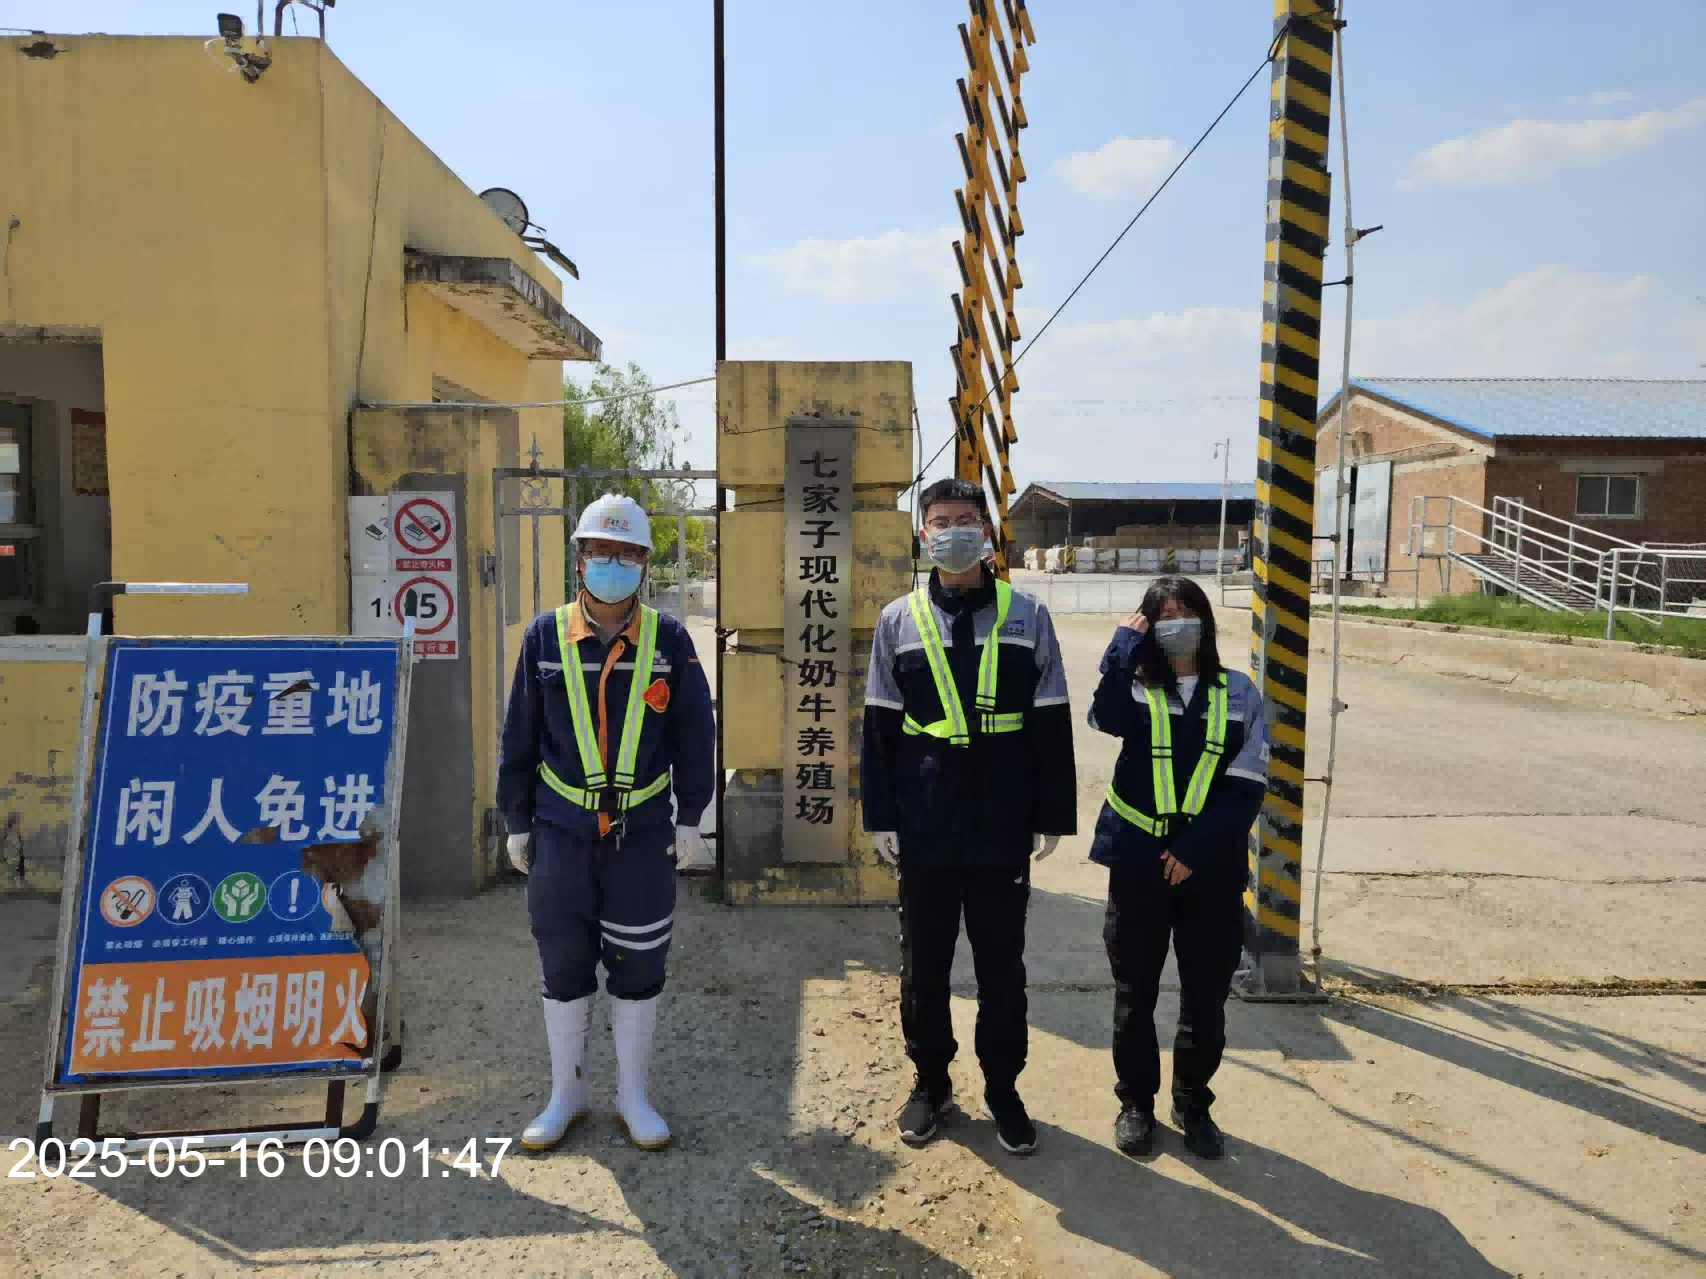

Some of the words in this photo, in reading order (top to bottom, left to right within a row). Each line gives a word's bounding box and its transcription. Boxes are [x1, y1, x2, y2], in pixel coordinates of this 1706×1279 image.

[796, 450, 841, 825] 七家子现代化奶牛养殖场
[127, 669, 383, 737] 防疫重地
[115, 774, 376, 846] 闲人免进
[80, 969, 368, 1058] 禁止吸烟明火
